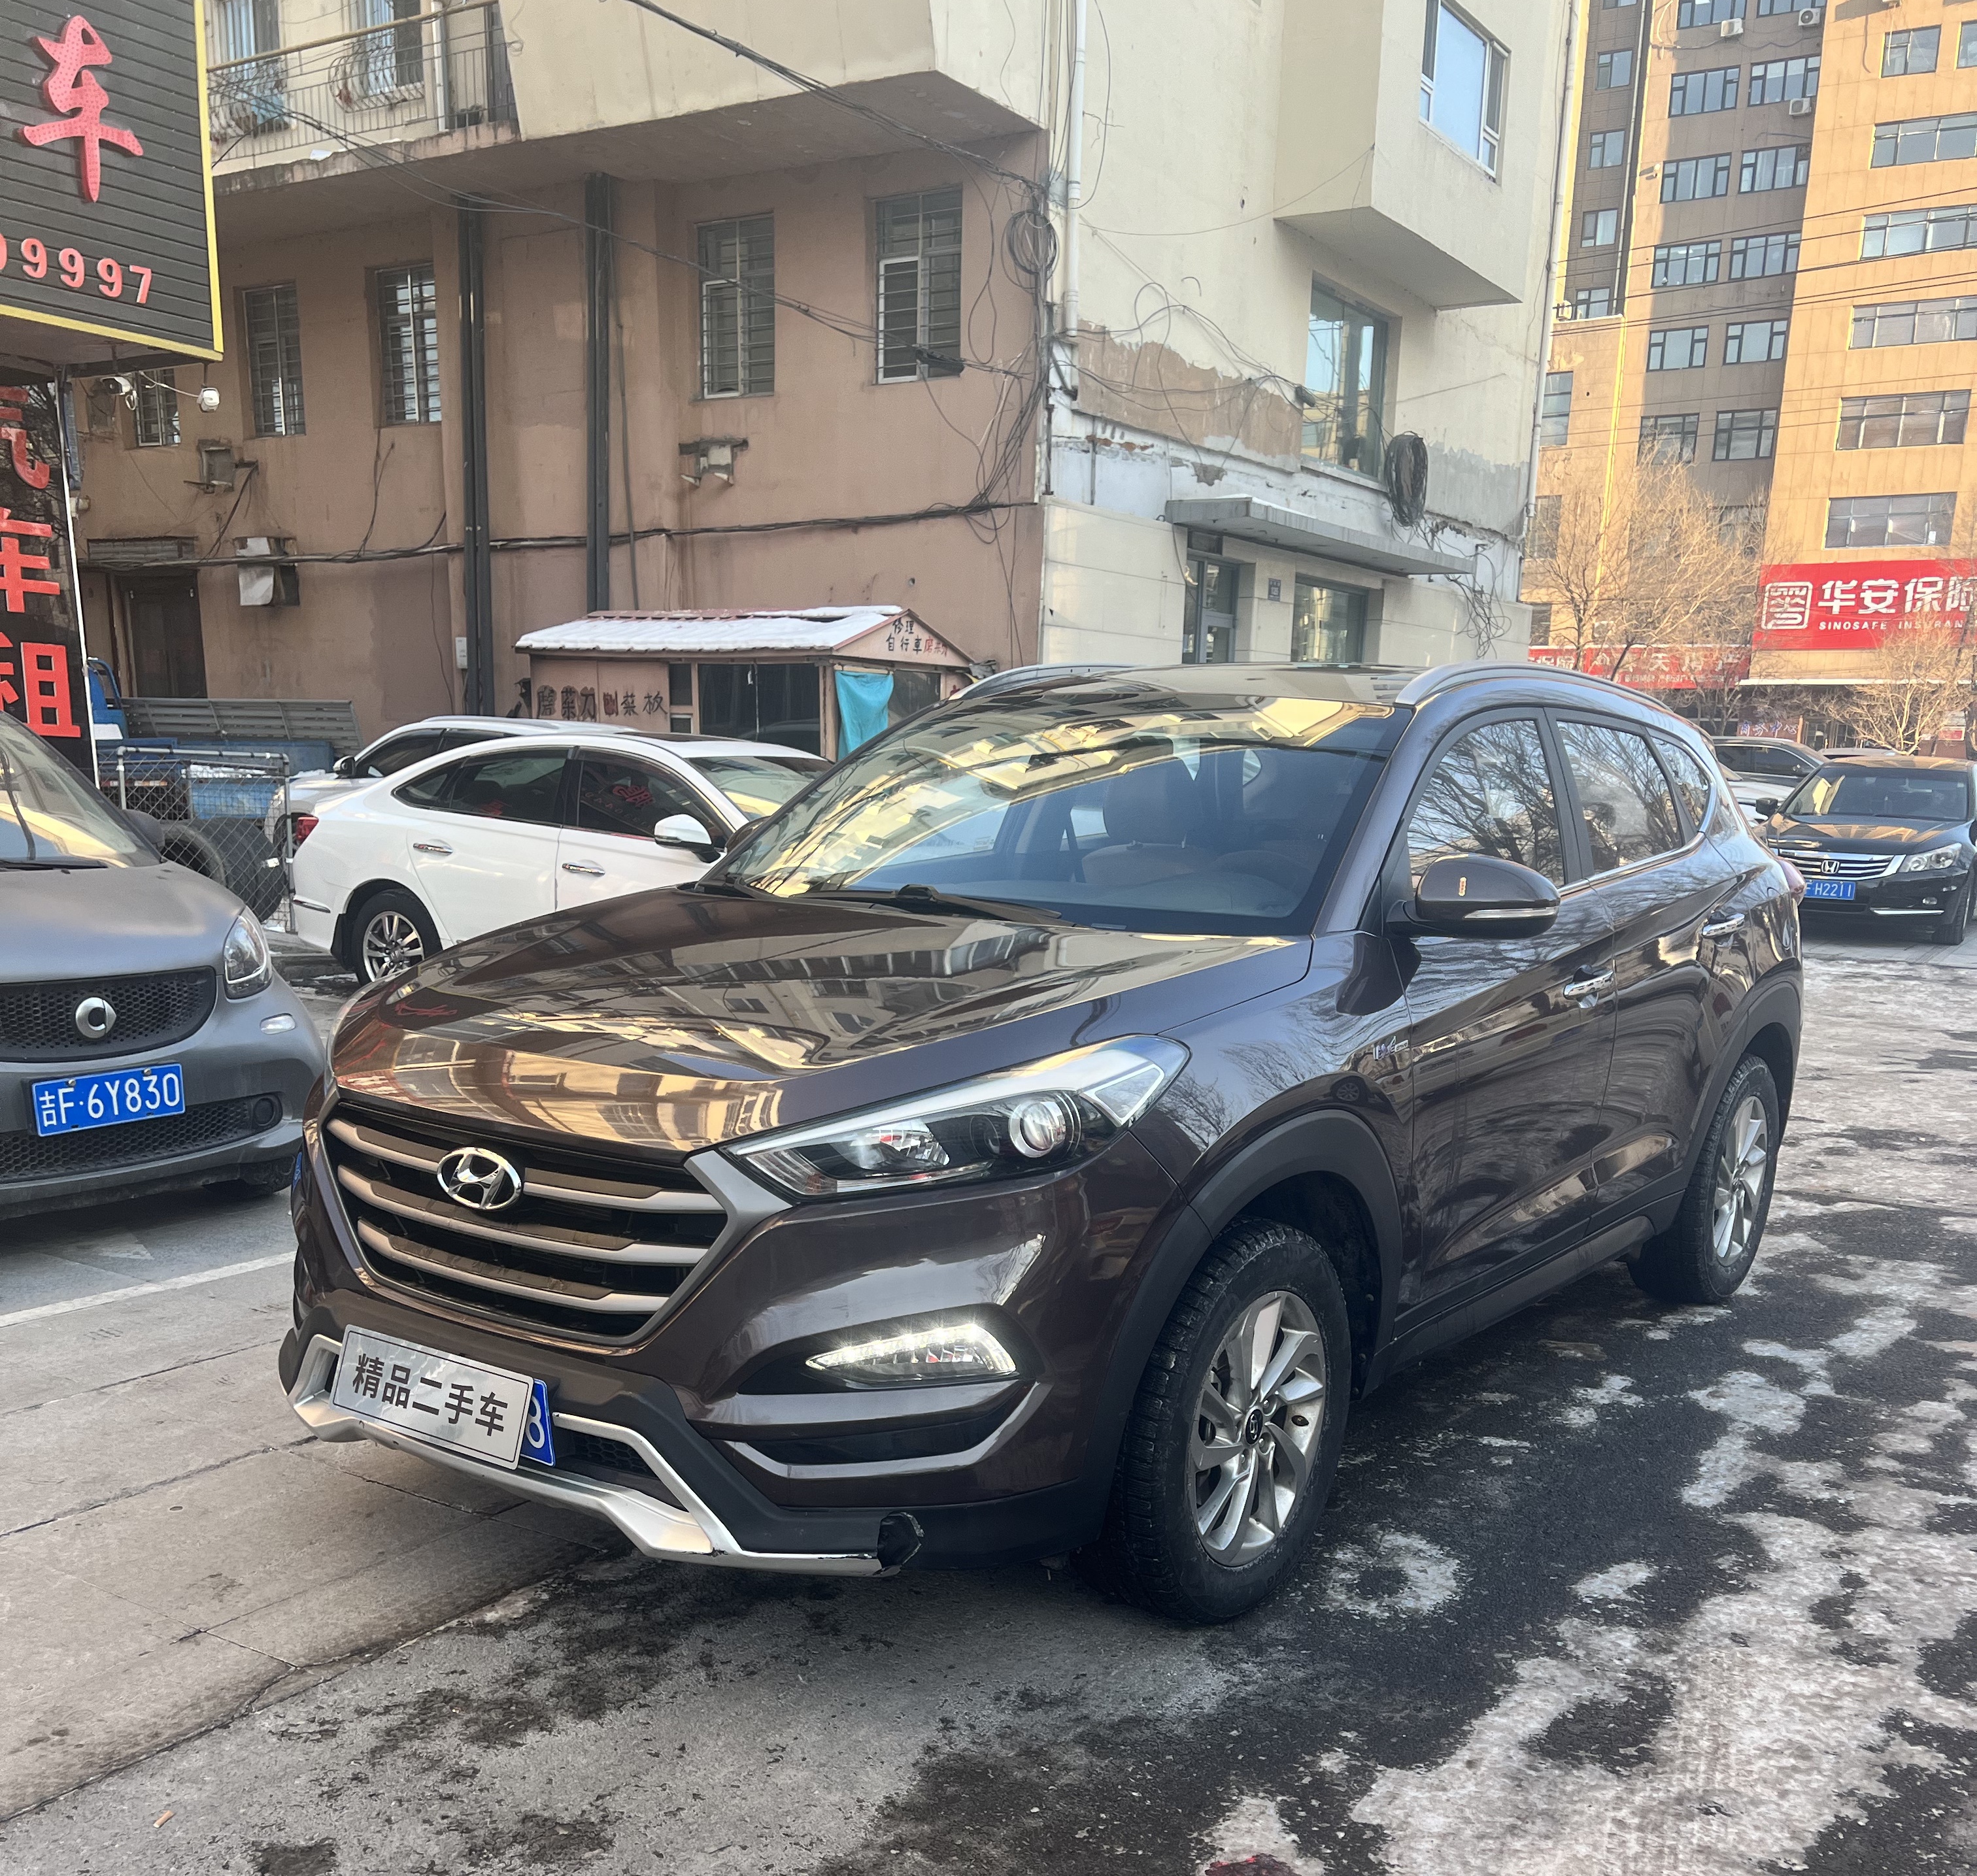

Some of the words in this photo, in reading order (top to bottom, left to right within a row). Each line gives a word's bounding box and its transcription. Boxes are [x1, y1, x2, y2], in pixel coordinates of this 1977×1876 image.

[0, 233, 152, 304] 9997
[1817, 576, 1977, 614] 华安保险
[892, 617, 914, 634] 修理
[1818, 621, 1887, 630] SINOSAFE
[1740, 720, 1798, 739] 商务中心
[352, 1352, 509, 1437] 精品二手车
